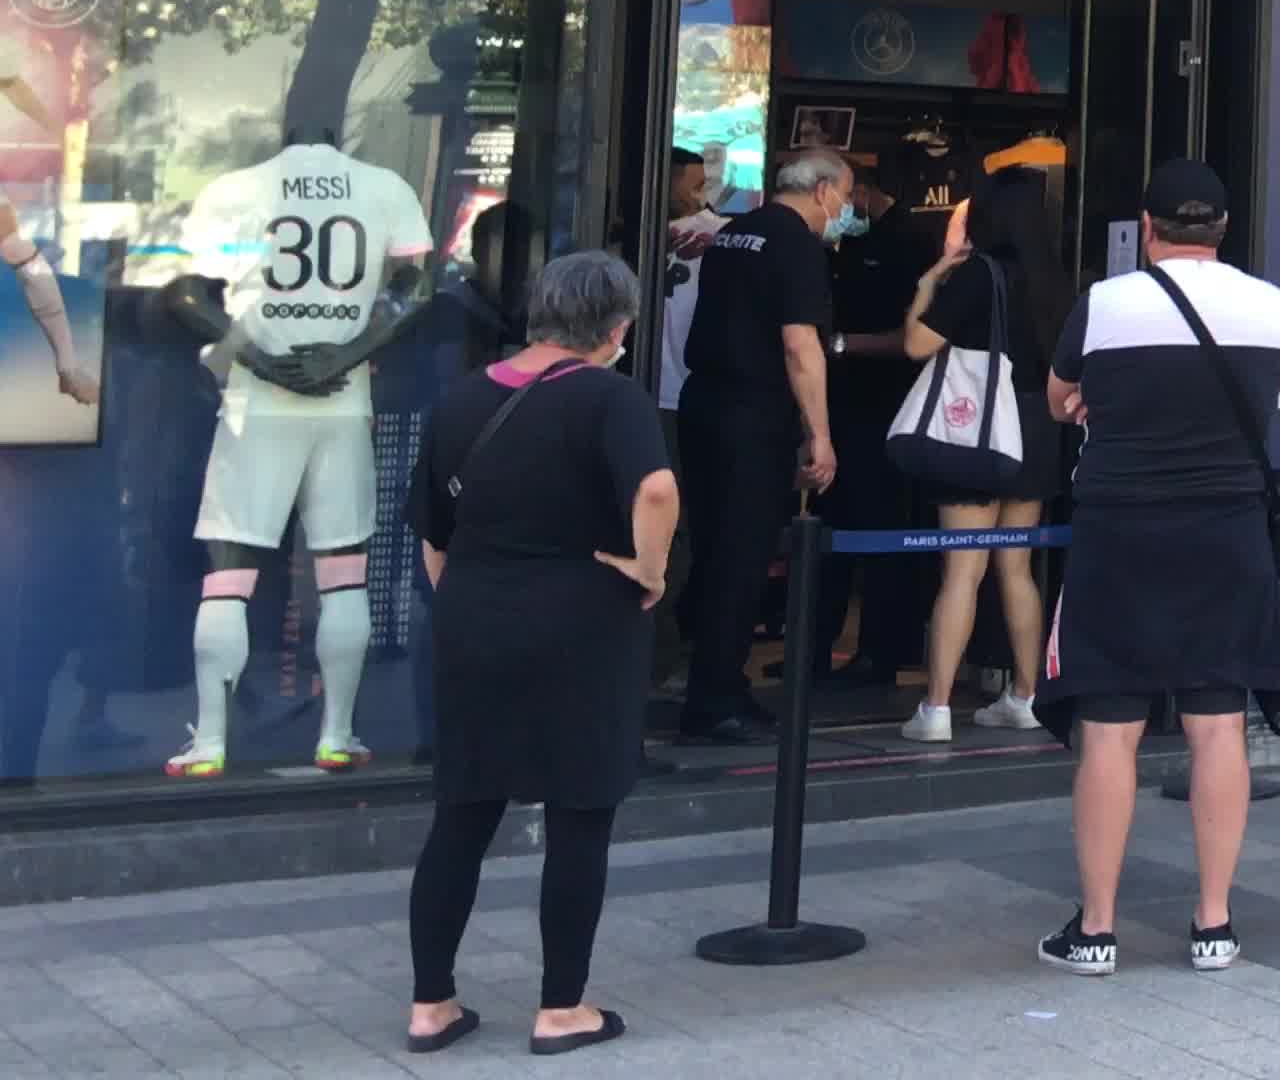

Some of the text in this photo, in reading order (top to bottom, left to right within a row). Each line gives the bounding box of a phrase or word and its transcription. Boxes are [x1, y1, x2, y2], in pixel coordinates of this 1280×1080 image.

[261, 215, 367, 291] 30
[903, 532, 1029, 547] PARIS SAINT-GERMAIN
